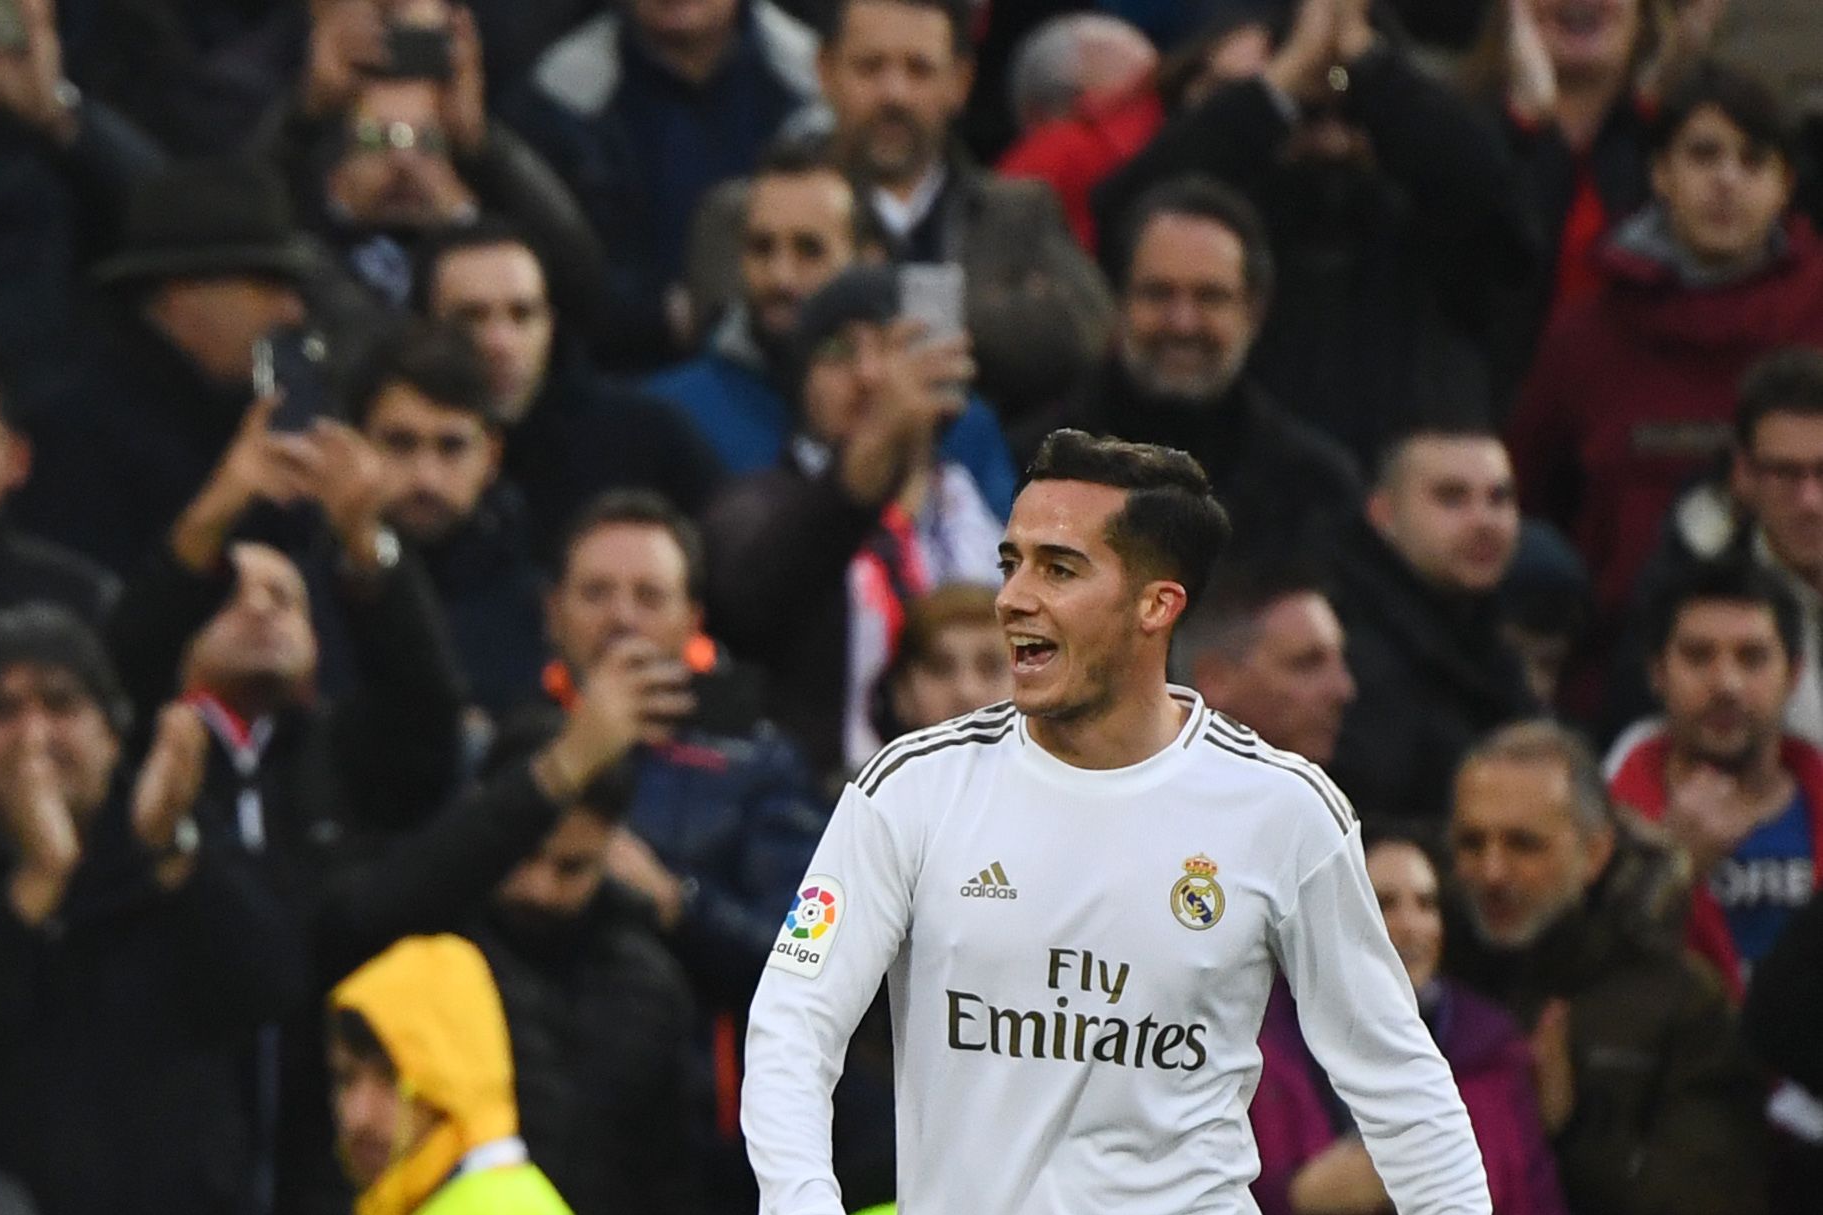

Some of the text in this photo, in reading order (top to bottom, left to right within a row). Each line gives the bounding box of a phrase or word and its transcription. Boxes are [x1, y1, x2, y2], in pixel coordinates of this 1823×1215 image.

[959, 883, 1018, 900] adidas
[1048, 947, 1131, 1005] Fly
[945, 988, 1208, 1072] Emirates
